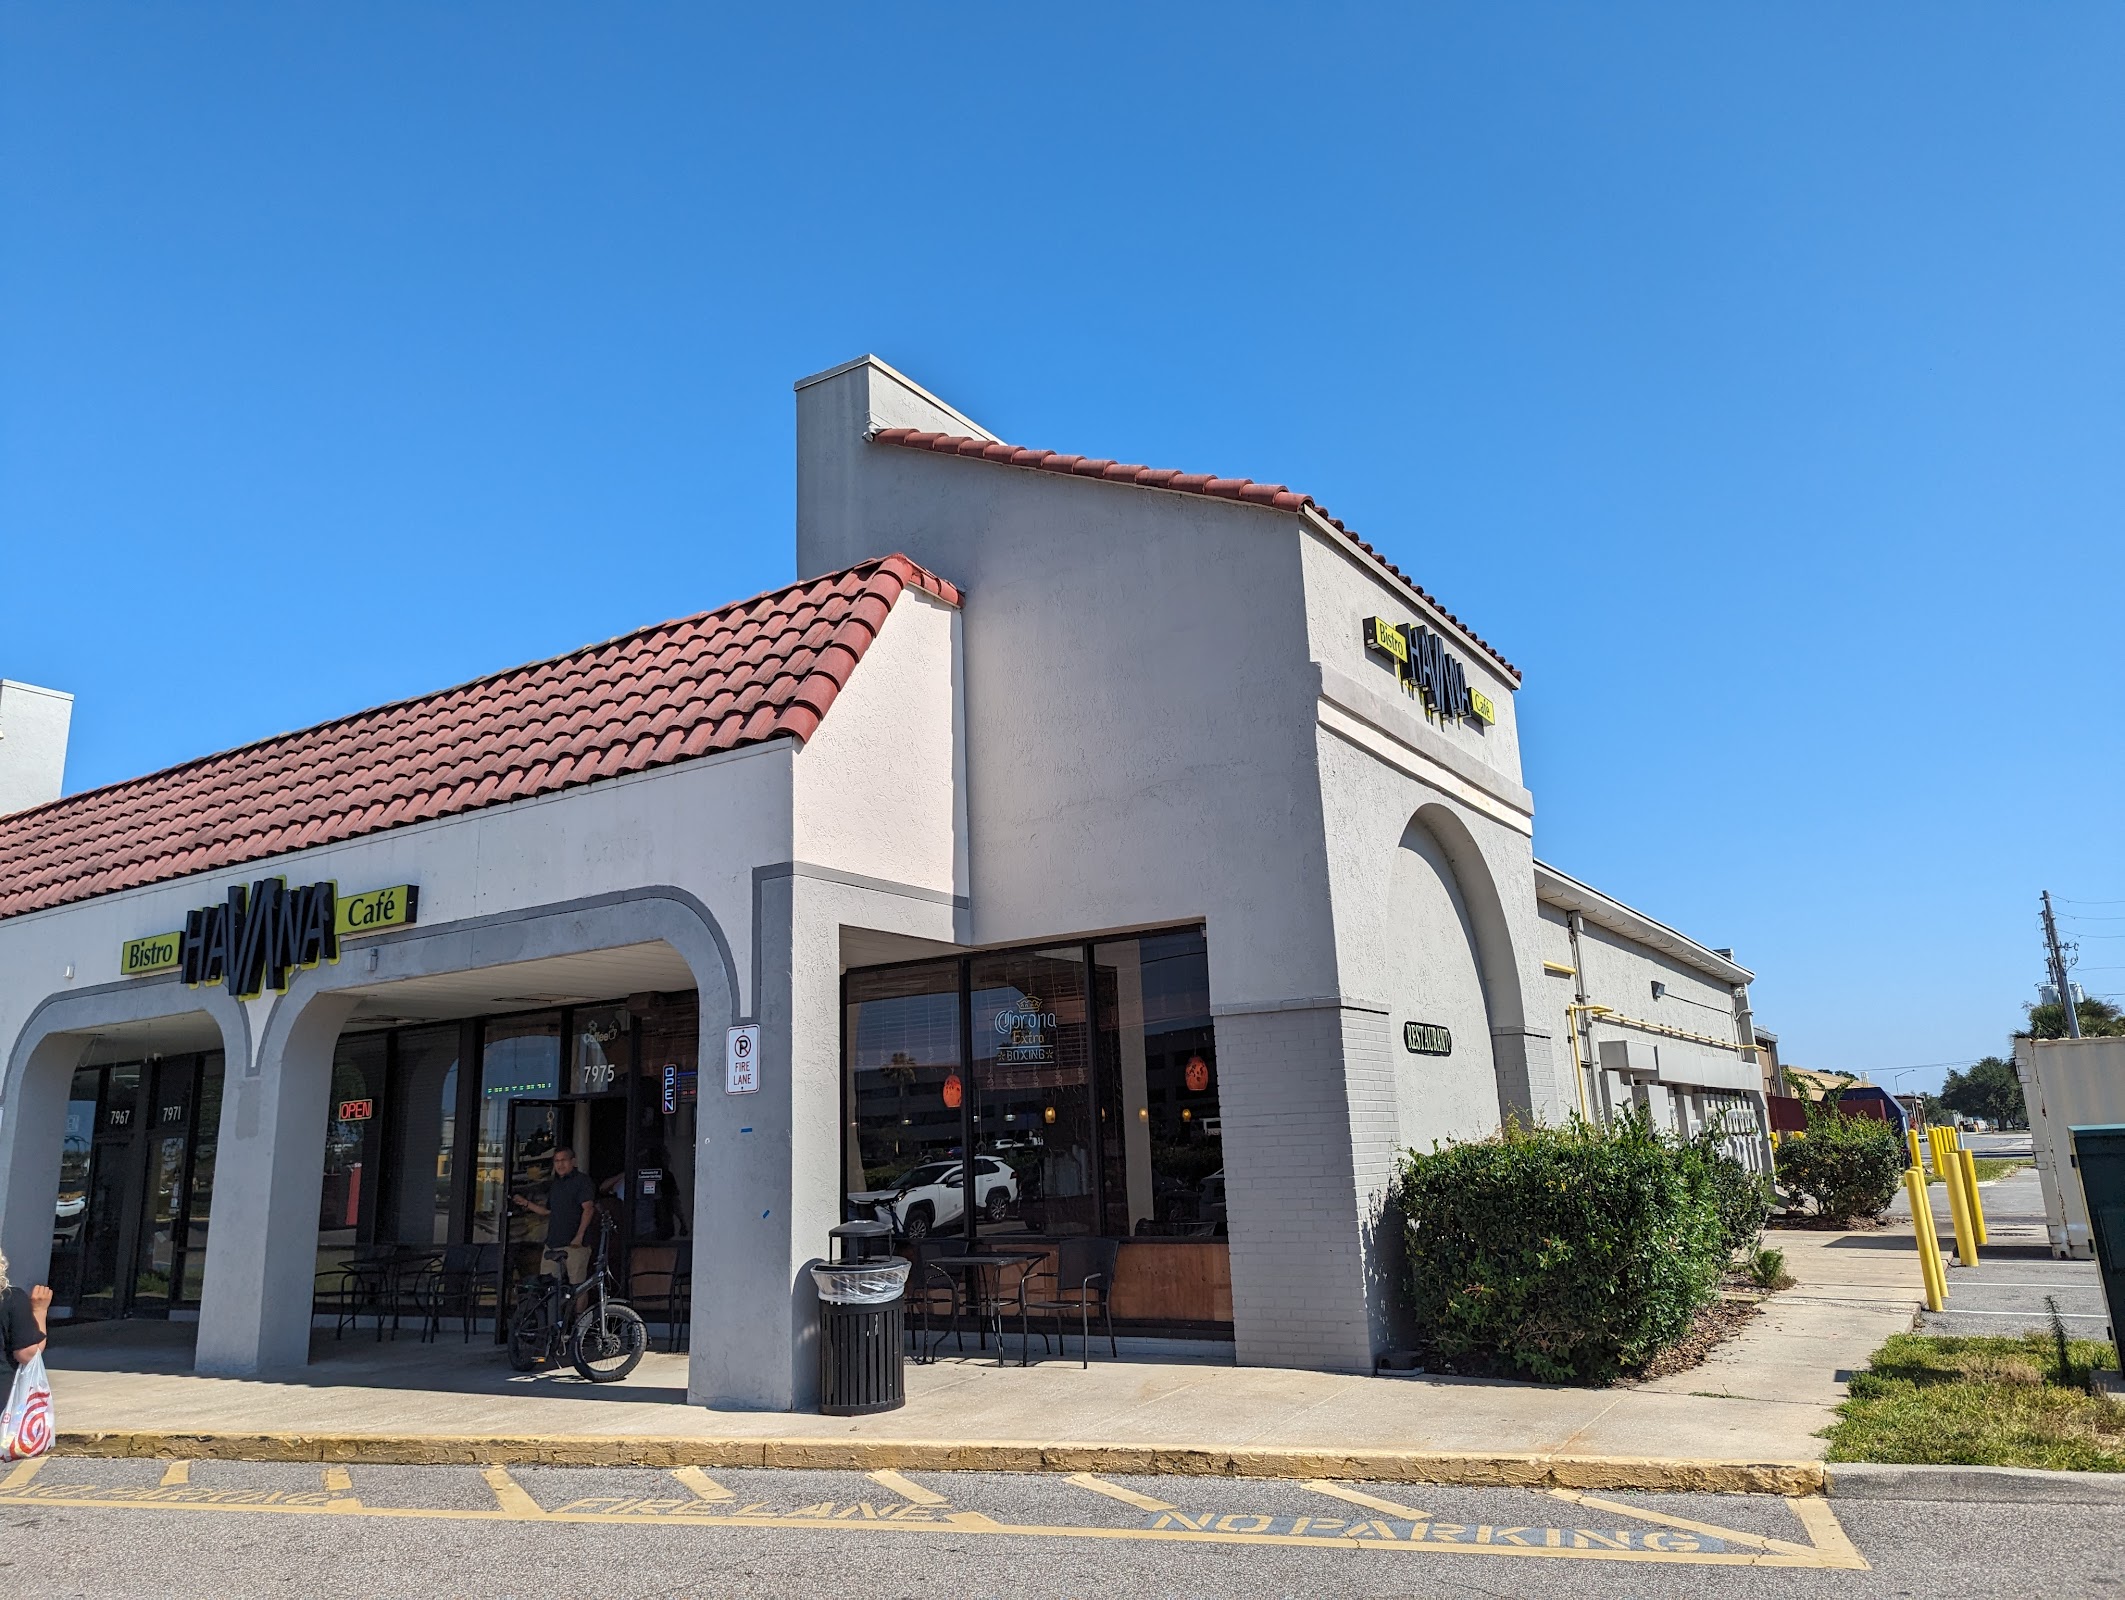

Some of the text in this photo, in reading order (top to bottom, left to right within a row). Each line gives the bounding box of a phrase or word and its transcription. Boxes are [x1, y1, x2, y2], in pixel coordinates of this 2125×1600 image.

[1379, 623, 1491, 719] Bistro HAVANA Café
[129, 877, 396, 996] Bistro HAVANA Café
[994, 1009, 1057, 1034] Corona
[583, 1031, 609, 1045] Coffee
[1012, 1030, 1045, 1045] Extra
[1406, 1023, 1450, 1053] RESTAURANT
[1006, 1048, 1045, 1061] BOXING
[584, 1064, 616, 1084] 7975
[735, 1061, 751, 1073] FIRE
[733, 1073, 752, 1086] LANE
[664, 1067, 674, 1112] OPEN
[110, 1110, 130, 1125] 7967
[163, 1106, 181, 1122] 7971
[341, 1101, 371, 1119] OPEN
[546, 1498, 953, 1521] FIRE LANE
[1151, 1511, 1701, 1552] NO PARKING
